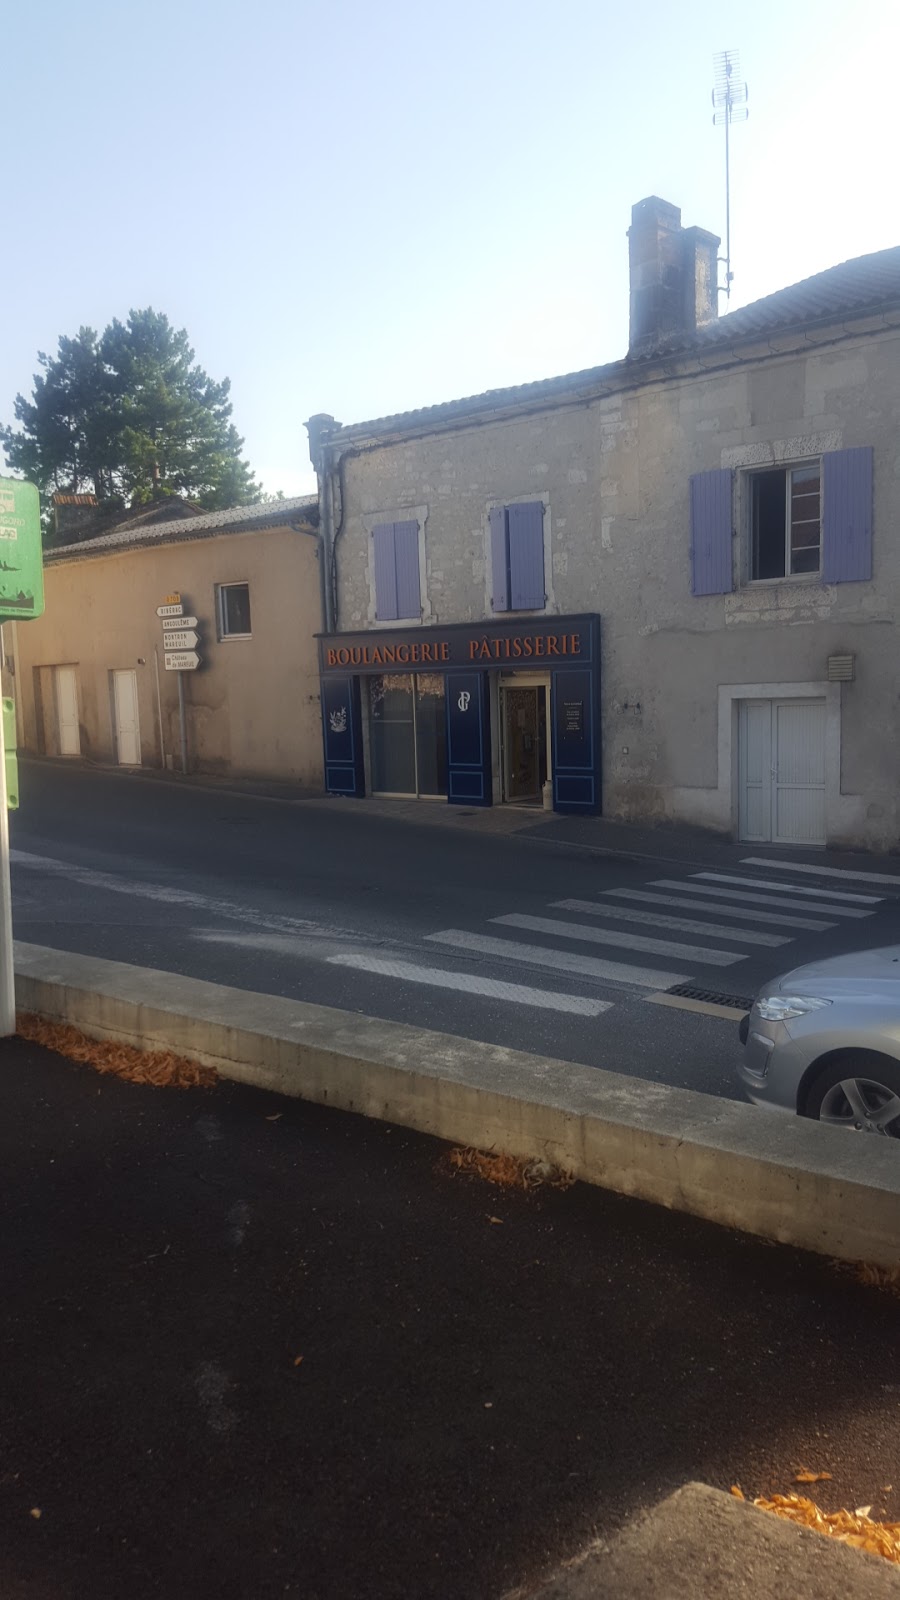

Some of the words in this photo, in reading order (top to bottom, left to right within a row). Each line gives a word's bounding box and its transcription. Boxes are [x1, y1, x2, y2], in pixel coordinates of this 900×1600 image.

[164, 619, 190, 627] ANGOULÊME
[327, 642, 450, 666] BOULANGERIE
[469, 634, 581, 660] PÂTISSERIE
